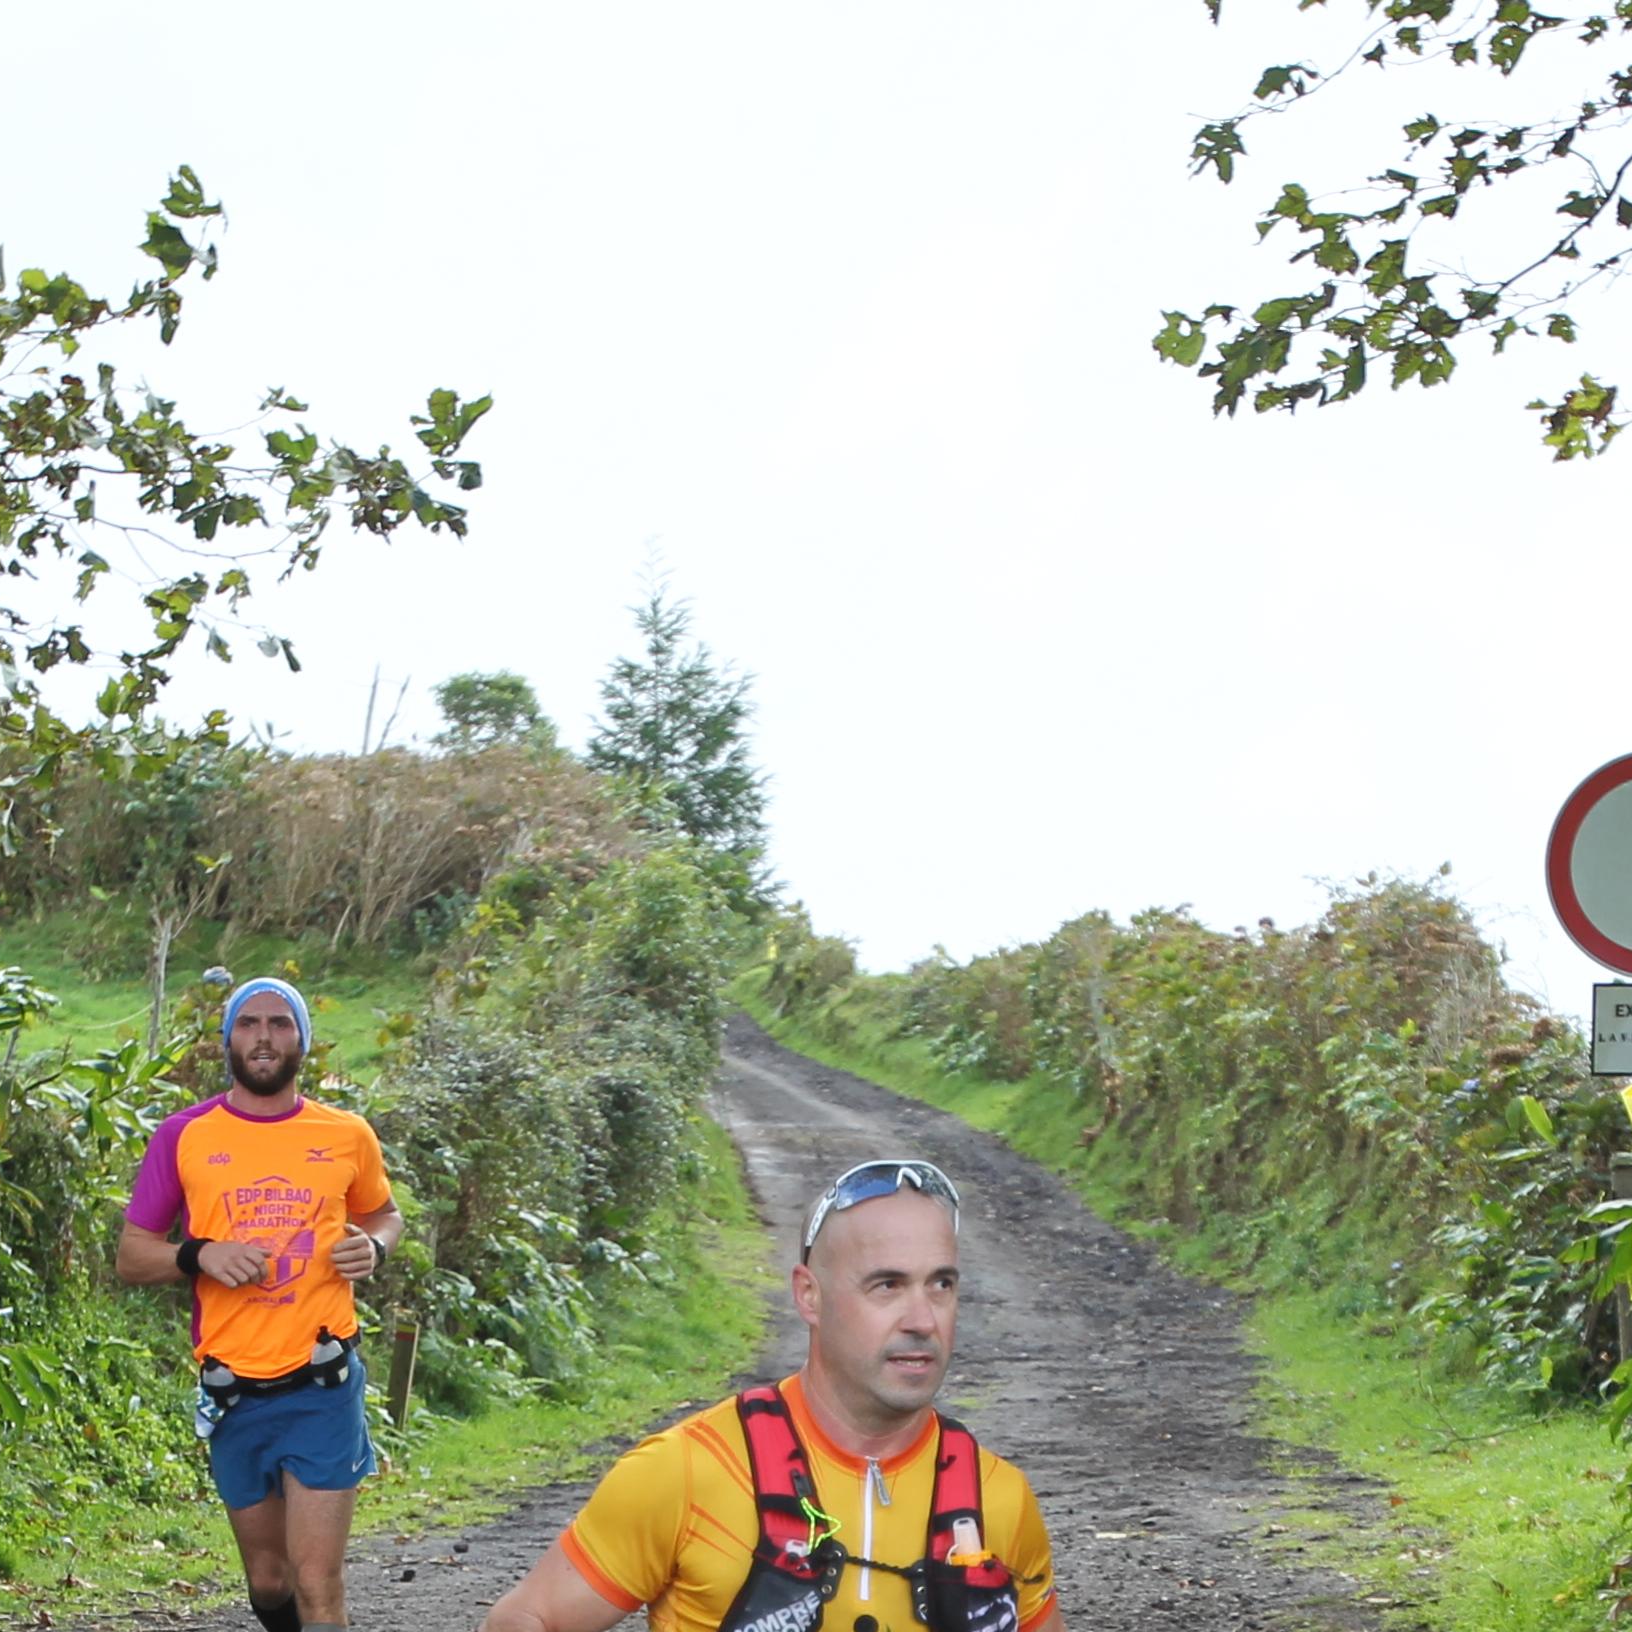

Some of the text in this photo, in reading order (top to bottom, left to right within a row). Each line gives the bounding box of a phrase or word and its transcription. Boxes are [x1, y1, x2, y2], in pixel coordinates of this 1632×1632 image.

[236, 1188, 312, 1206] EDP BILBAO
[254, 1204, 294, 1216] NIGHT
[238, 1217, 306, 1228] MARATHON
